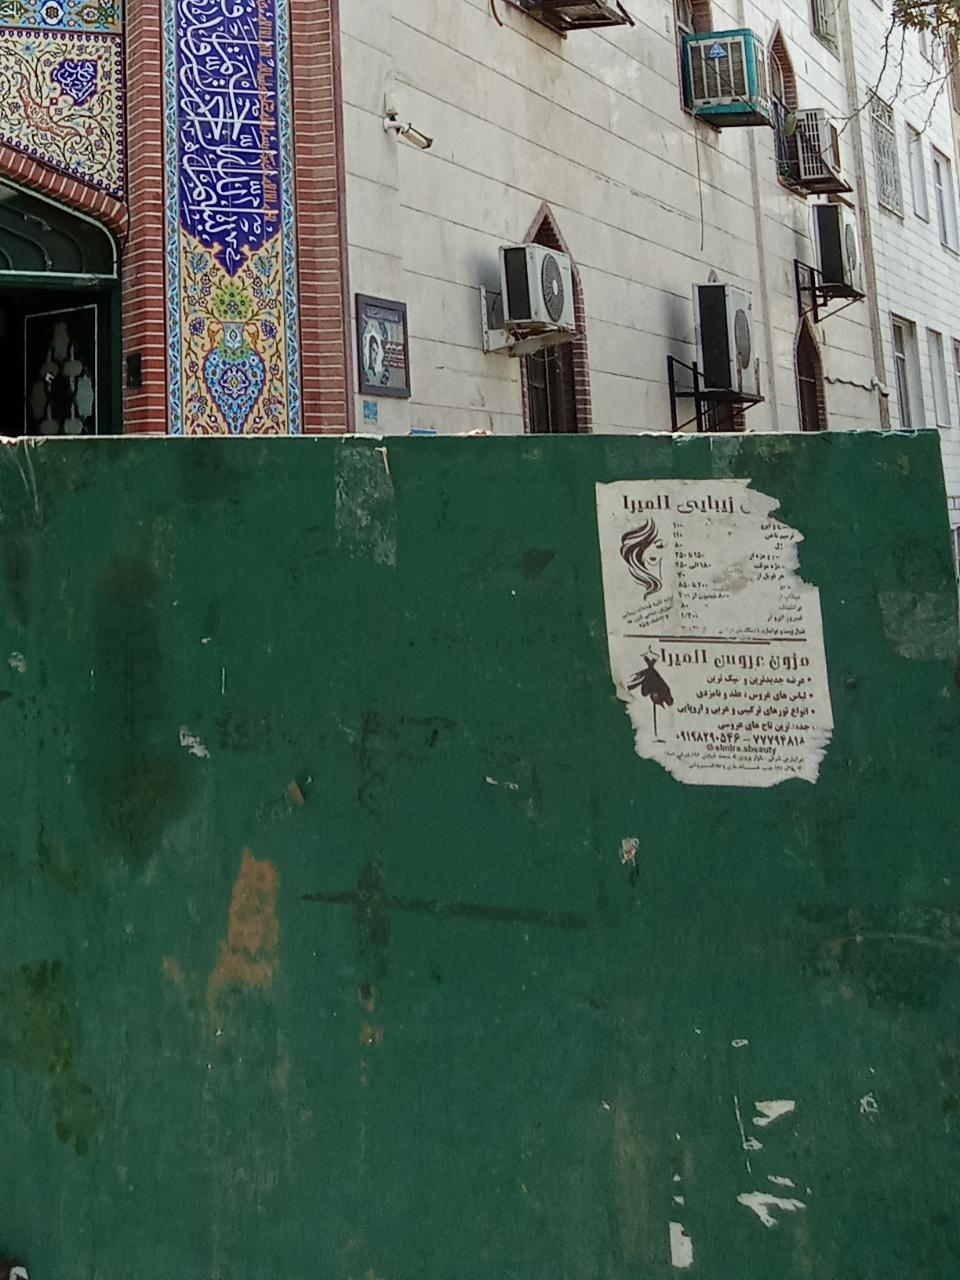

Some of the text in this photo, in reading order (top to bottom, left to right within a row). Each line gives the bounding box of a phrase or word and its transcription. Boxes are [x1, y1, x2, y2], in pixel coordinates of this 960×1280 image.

[622, 494, 671, 514] المیرا
[676, 495, 734, 514] زیبایی
[660, 648, 810, 670] مزون عروس المیرا
